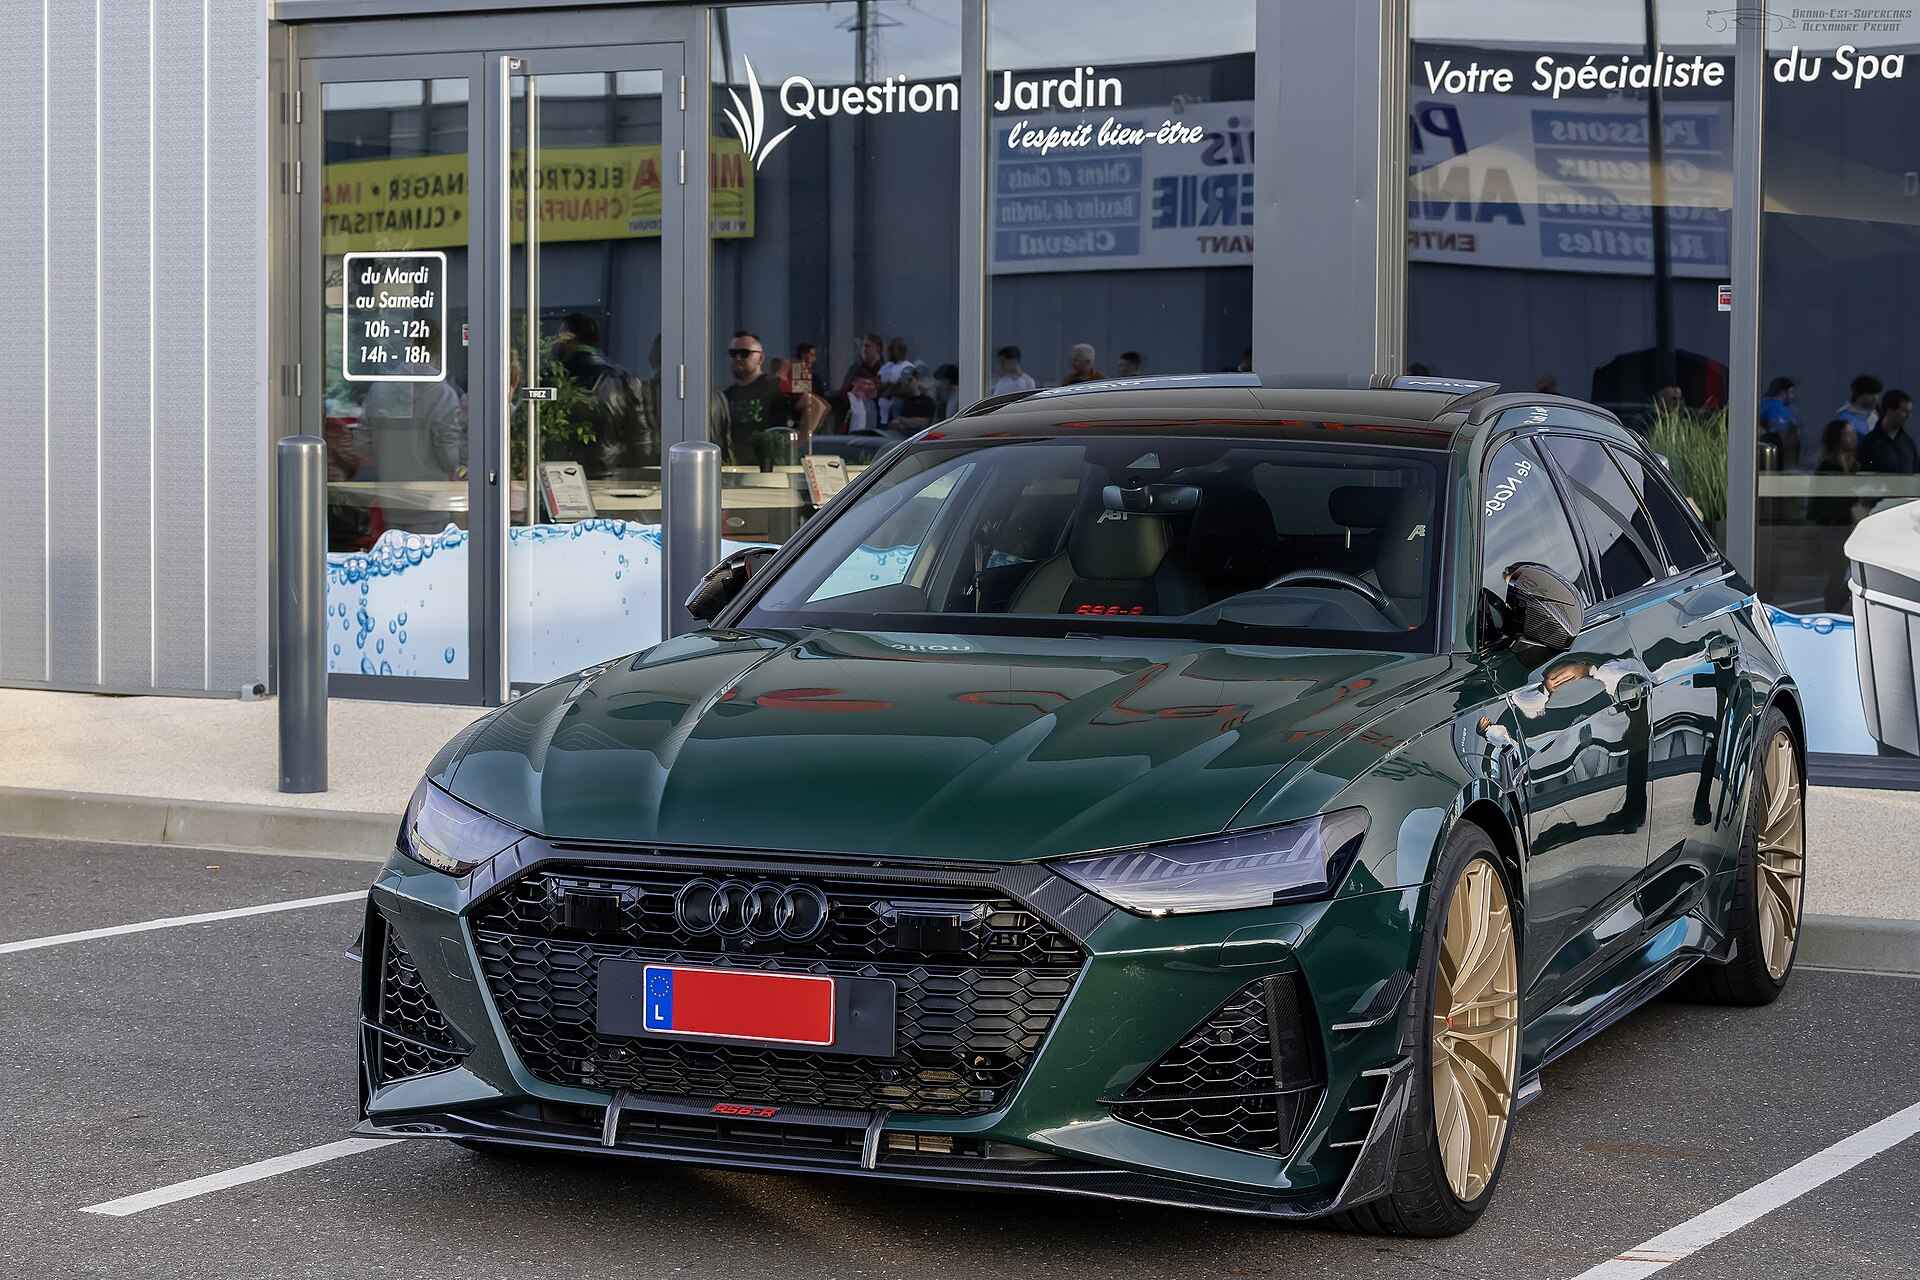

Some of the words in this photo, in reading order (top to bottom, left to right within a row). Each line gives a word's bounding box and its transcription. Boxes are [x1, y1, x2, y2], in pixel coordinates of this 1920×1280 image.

[1423, 60, 1514, 94] Votre
[1531, 51, 1725, 100] Spécialiste
[1773, 45, 1822, 83] du
[1831, 44, 1905, 89] Spa
[780, 73, 959, 119] Question
[993, 66, 1122, 111] Jardin
[1007, 120, 1092, 156] l'esprit
[1097, 116, 1204, 147] bien-être
[361, 266, 380, 285] du
[383, 266, 429, 285] Mardi
[356, 296, 375, 309] au
[378, 290, 434, 309] Samedi
[364, 320, 390, 338] 10h
[361, 346, 388, 363] 14h
[404, 346, 430, 364] 18h
[654, 1004, 665, 1021] L
[711, 1102, 777, 1118] RS6-R
